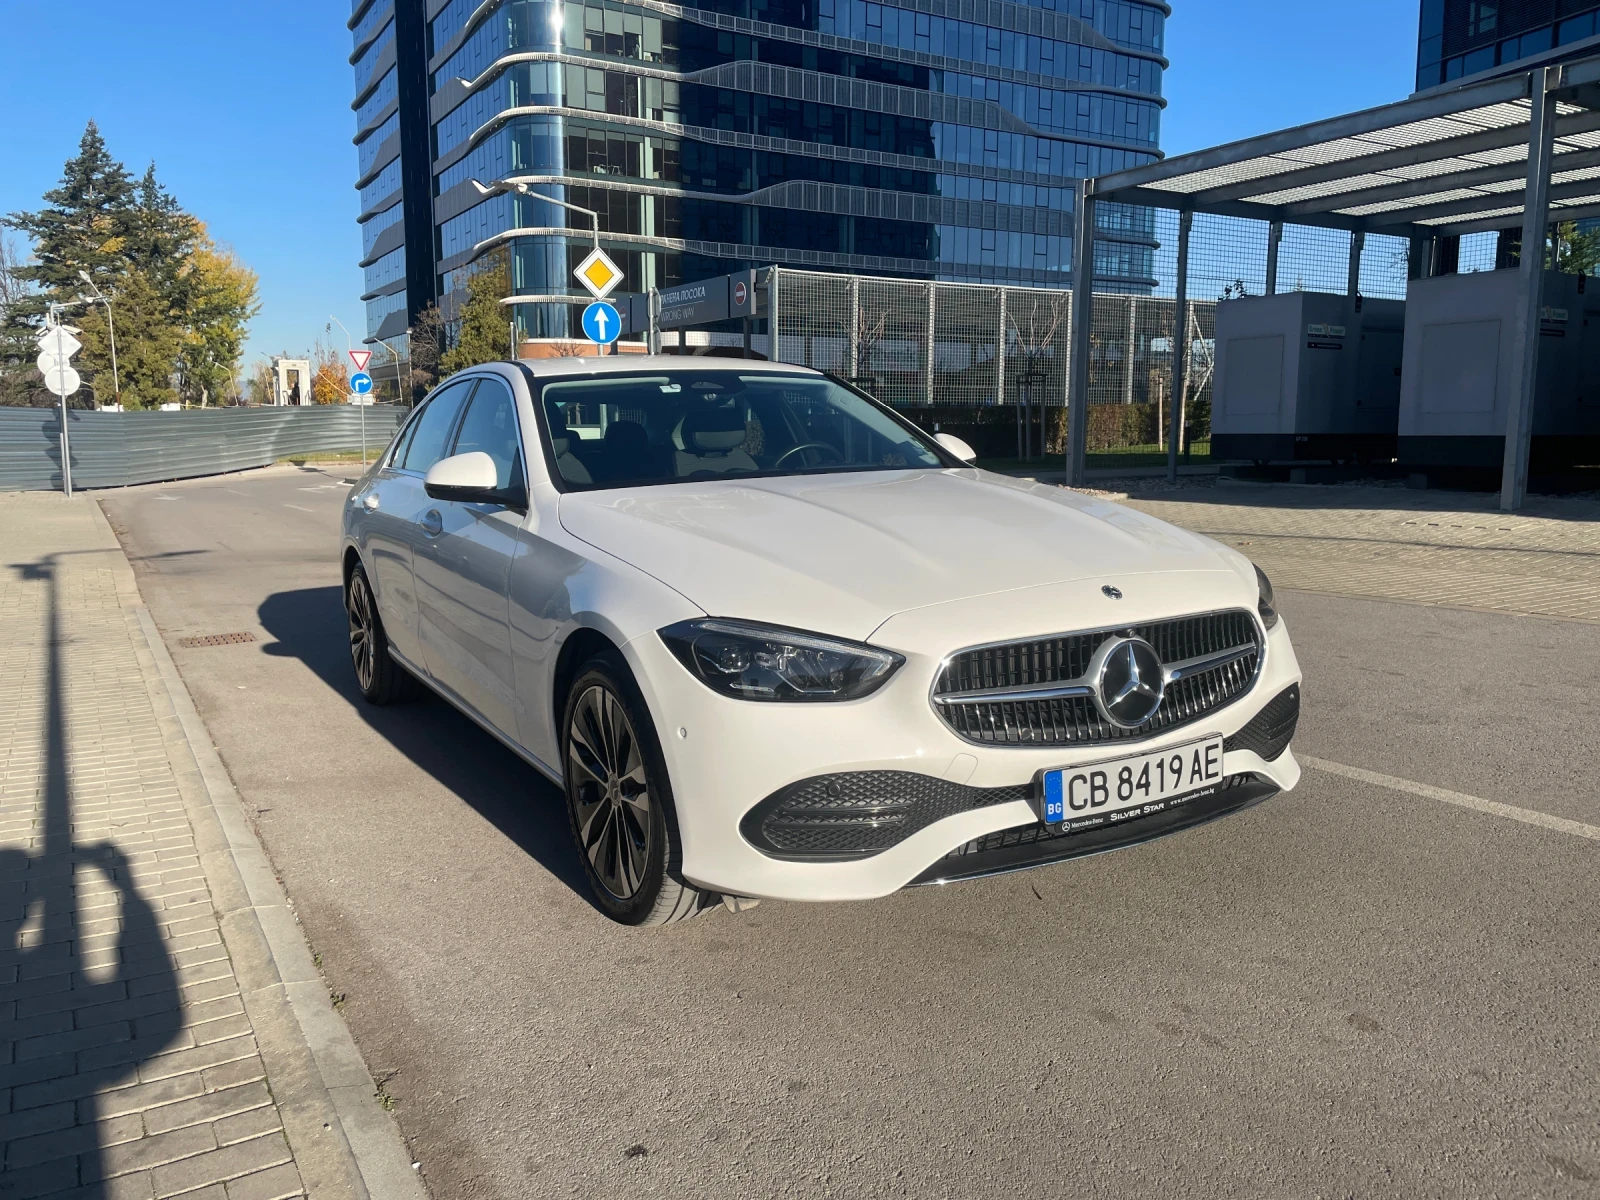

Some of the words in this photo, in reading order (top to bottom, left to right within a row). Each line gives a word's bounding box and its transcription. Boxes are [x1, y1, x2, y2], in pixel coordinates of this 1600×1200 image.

[661, 291, 680, 304] РАНЕНА
[681, 286, 706, 301] ПОСОКА
[661, 308, 682, 322] WRONG
[682, 307, 695, 318] WAY
[1068, 770, 1109, 811] CB
[1117, 754, 1183, 801] 8419
[1189, 743, 1220, 784] AE
[1048, 803, 1062, 815] BG
[1110, 808, 1141, 822] SILVER
[1143, 802, 1165, 815] STAR
[1071, 818, 1104, 829] Mercedes-Benz
